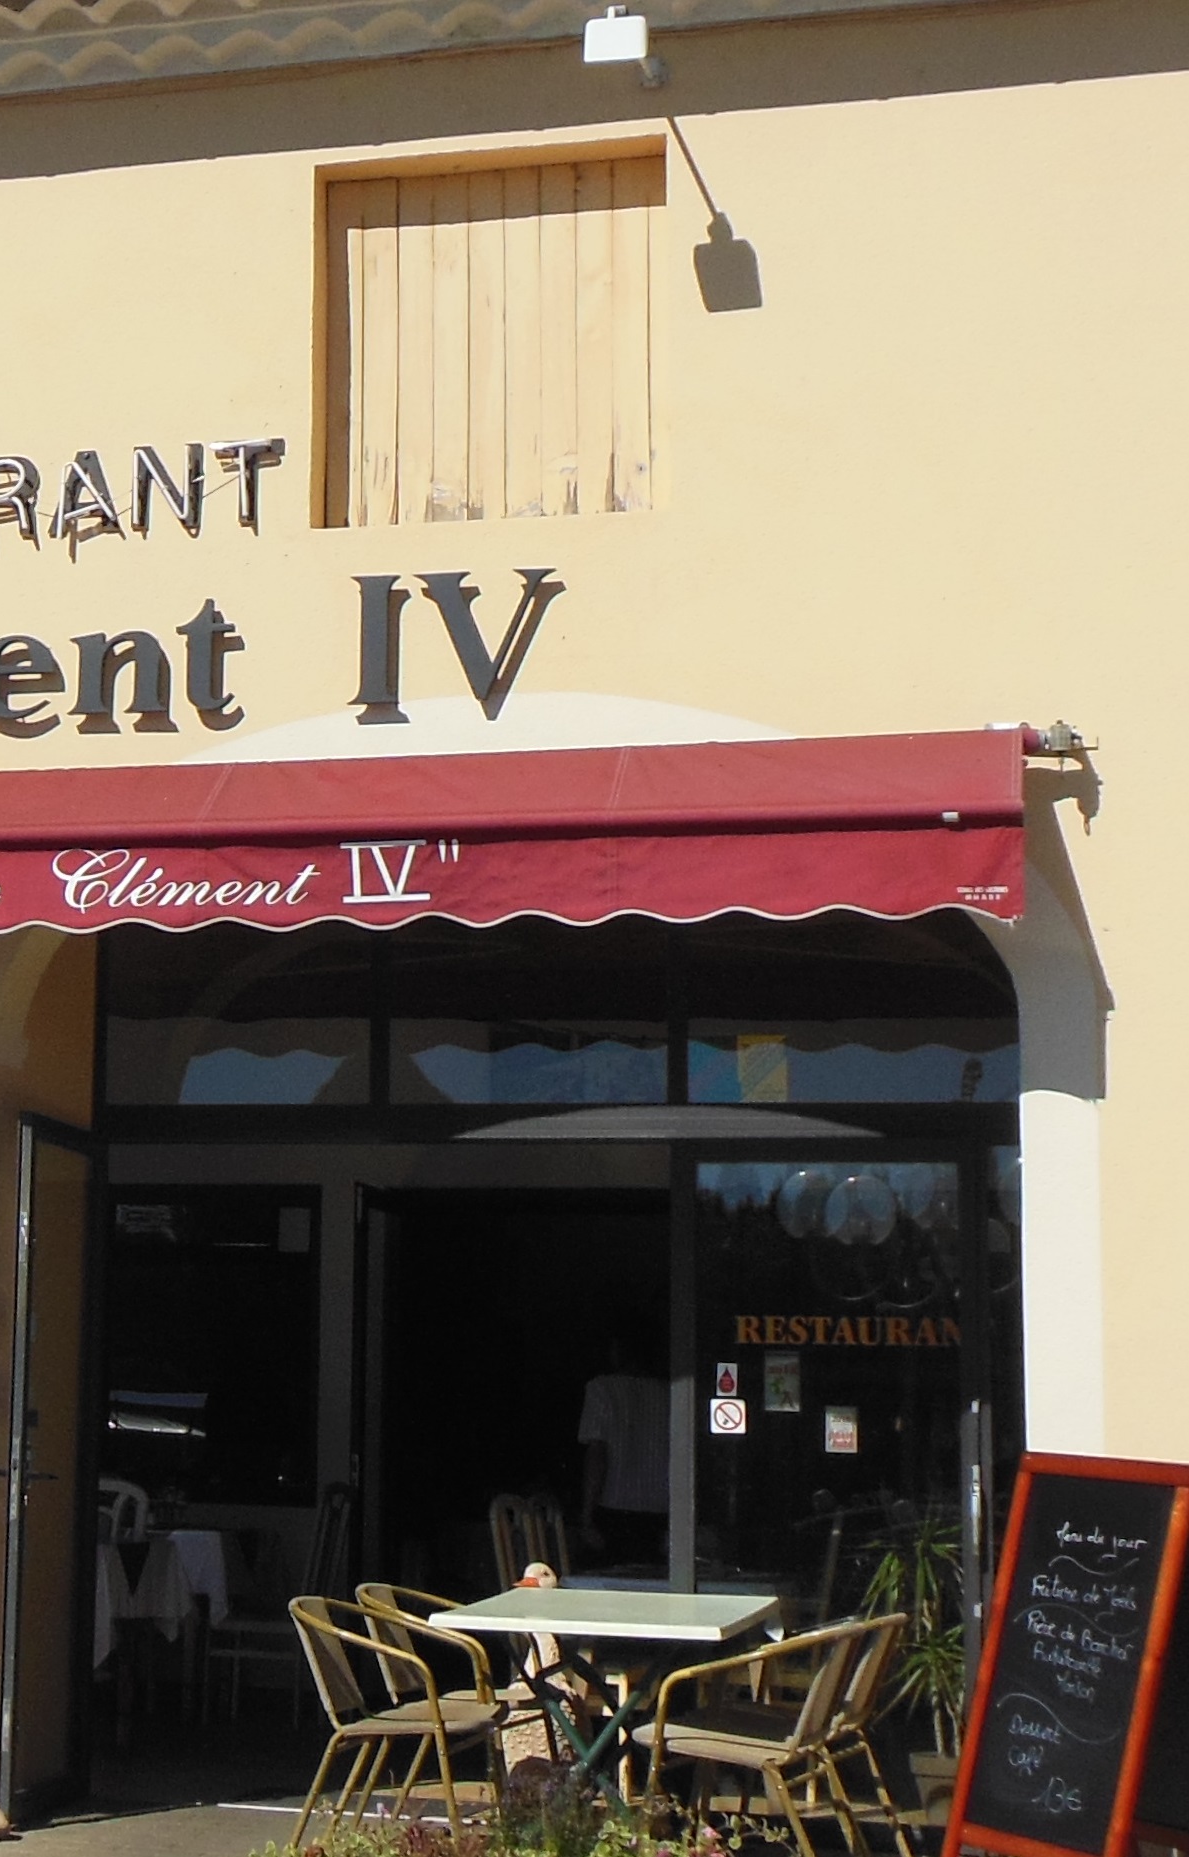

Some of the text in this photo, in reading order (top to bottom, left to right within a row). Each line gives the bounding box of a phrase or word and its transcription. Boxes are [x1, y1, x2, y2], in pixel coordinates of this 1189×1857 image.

[347, 567, 562, 714] IV
[52, 848, 321, 914] Clément
[734, 1314, 962, 1347] RESTAURAN
